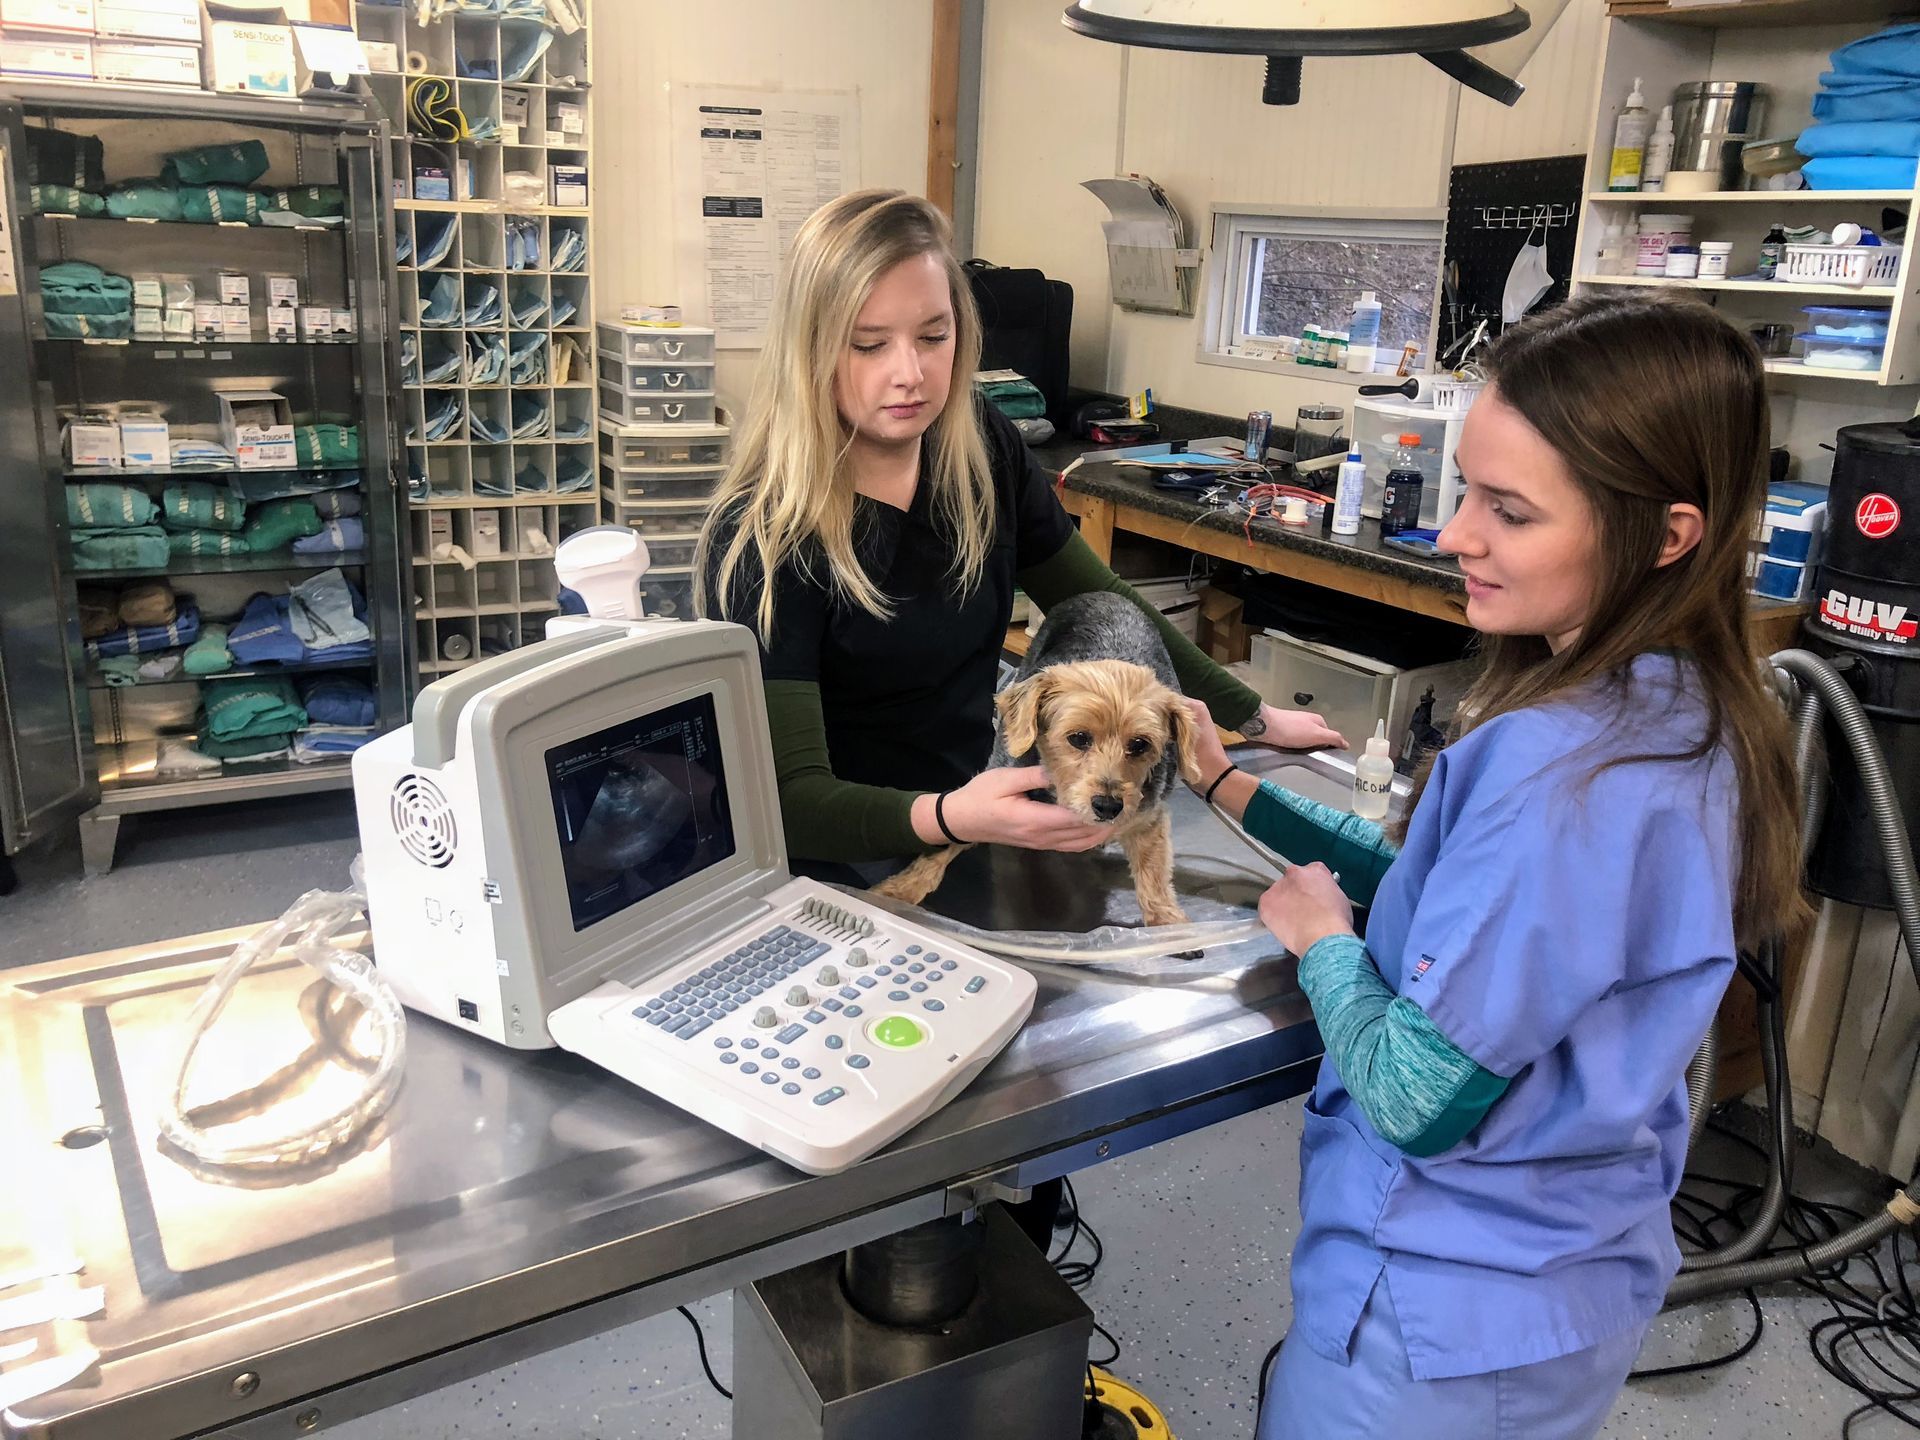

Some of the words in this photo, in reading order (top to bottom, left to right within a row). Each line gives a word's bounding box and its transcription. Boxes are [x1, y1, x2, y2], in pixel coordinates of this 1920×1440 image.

[1827, 590, 1907, 630] GUV
[1821, 613, 1847, 631] Garage
[1849, 623, 1881, 640] Utility
[1885, 631, 1908, 644] Vac
